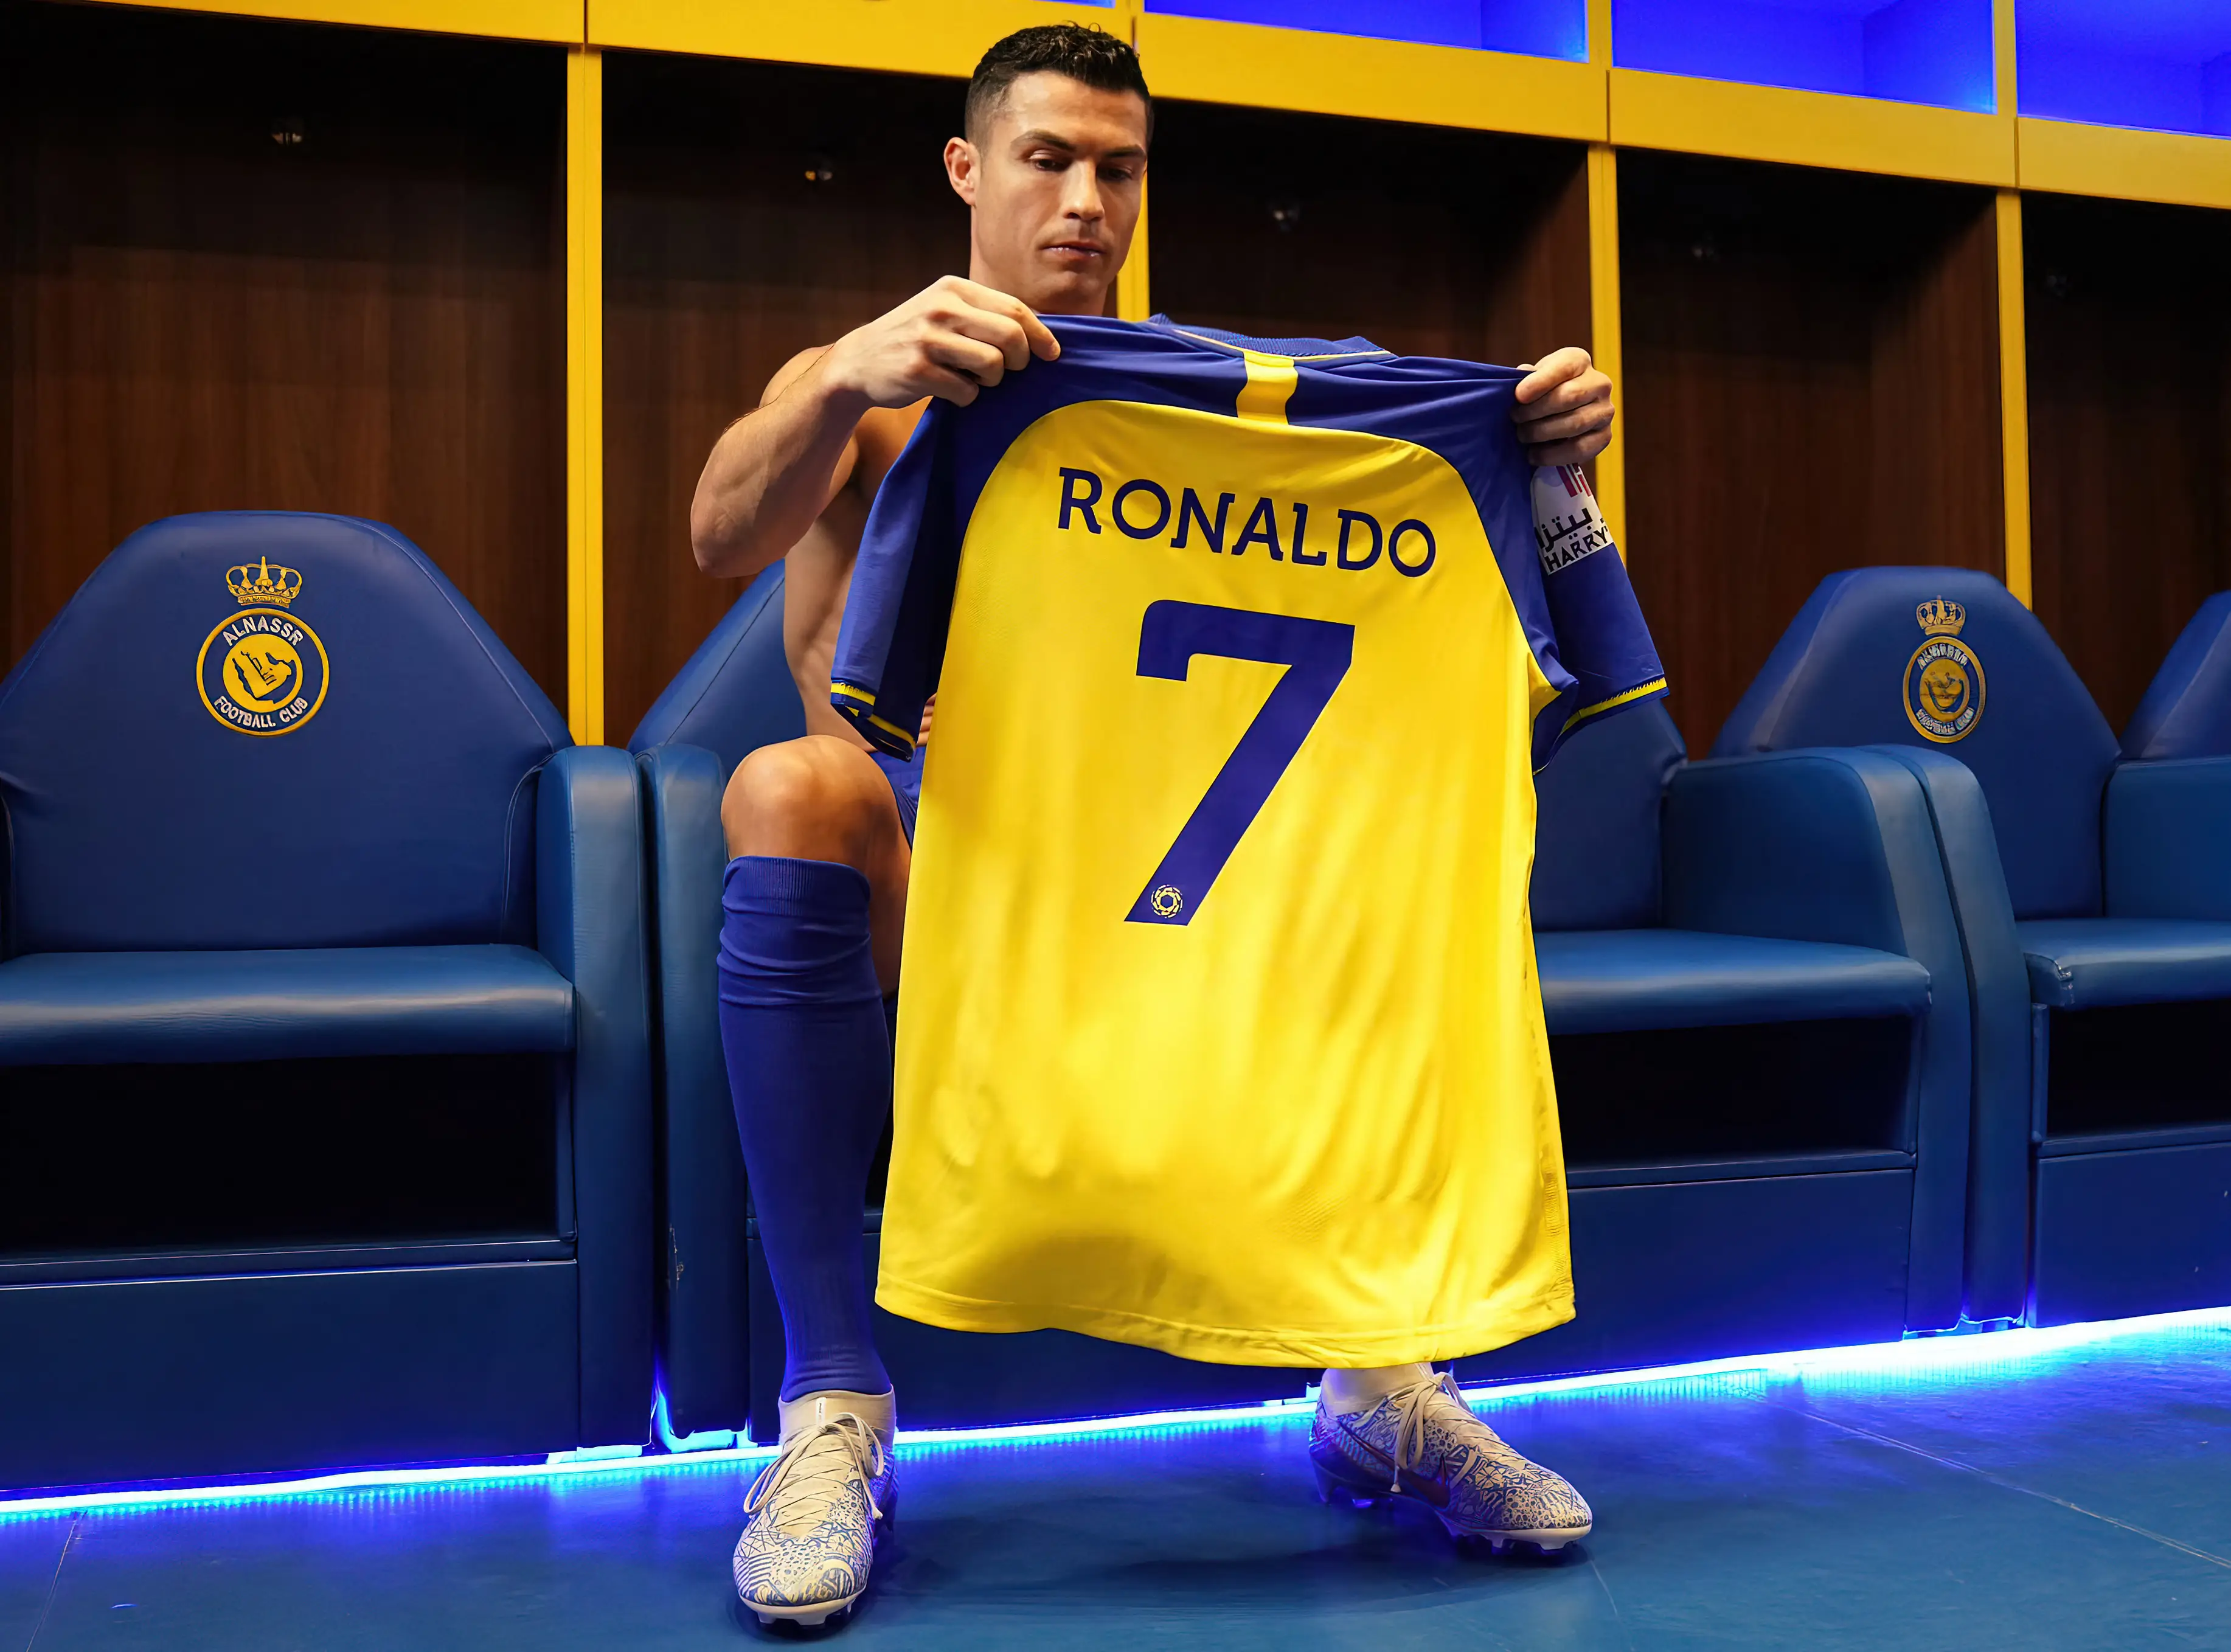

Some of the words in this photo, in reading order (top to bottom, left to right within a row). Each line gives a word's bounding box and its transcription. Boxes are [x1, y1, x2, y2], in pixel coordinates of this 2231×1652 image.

[1058, 467, 1436, 577] RONALDO
[223, 616, 304, 646] ALNASSR
[214, 696, 276, 728] FOOTBALL
[279, 697, 308, 723] CLUB
[1124, 600, 1355, 926] 7
